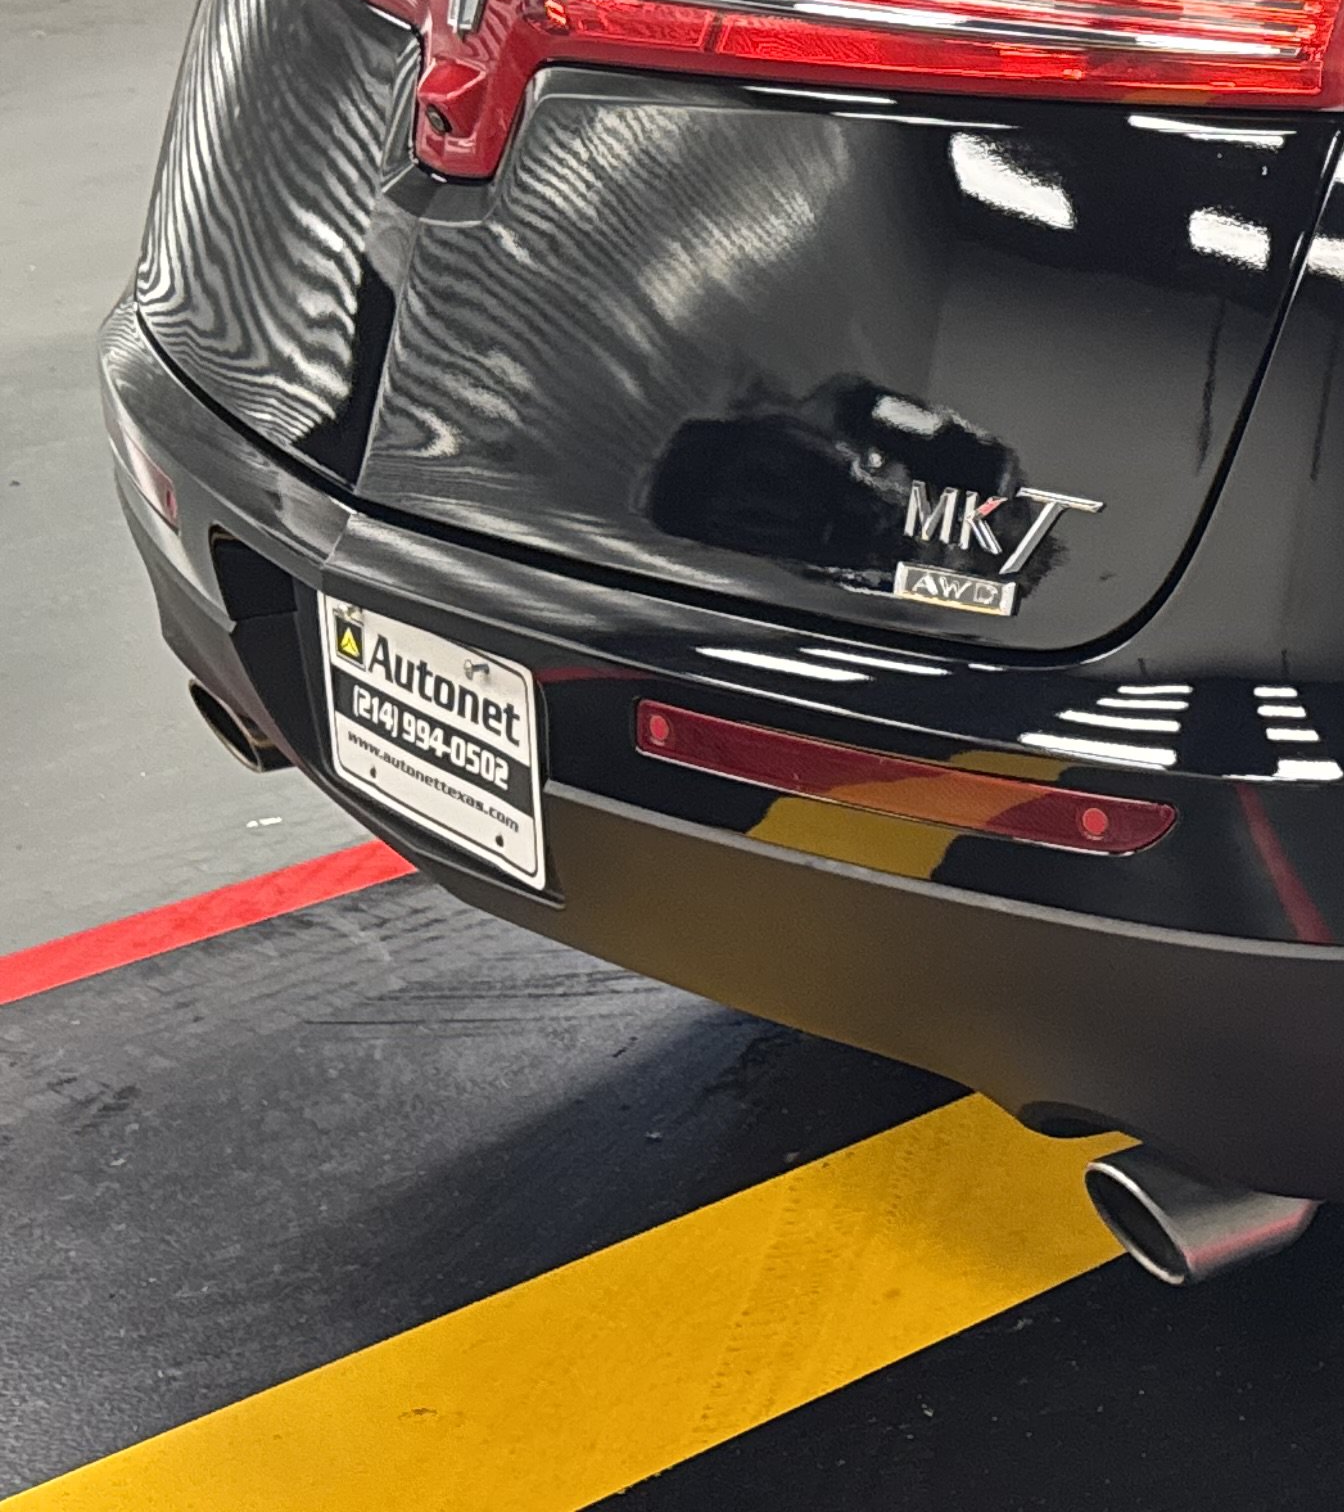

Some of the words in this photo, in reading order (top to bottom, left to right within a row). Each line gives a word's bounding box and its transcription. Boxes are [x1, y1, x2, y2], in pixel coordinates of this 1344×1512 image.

[903, 479, 1104, 575] MKT
[911, 571, 999, 605] AWD
[354, 685, 398, 737] (214)
[402, 712, 509, 792] 994-0502
[367, 633, 521, 747] Autonet
[347, 731, 520, 833] www.autonettexas.com
